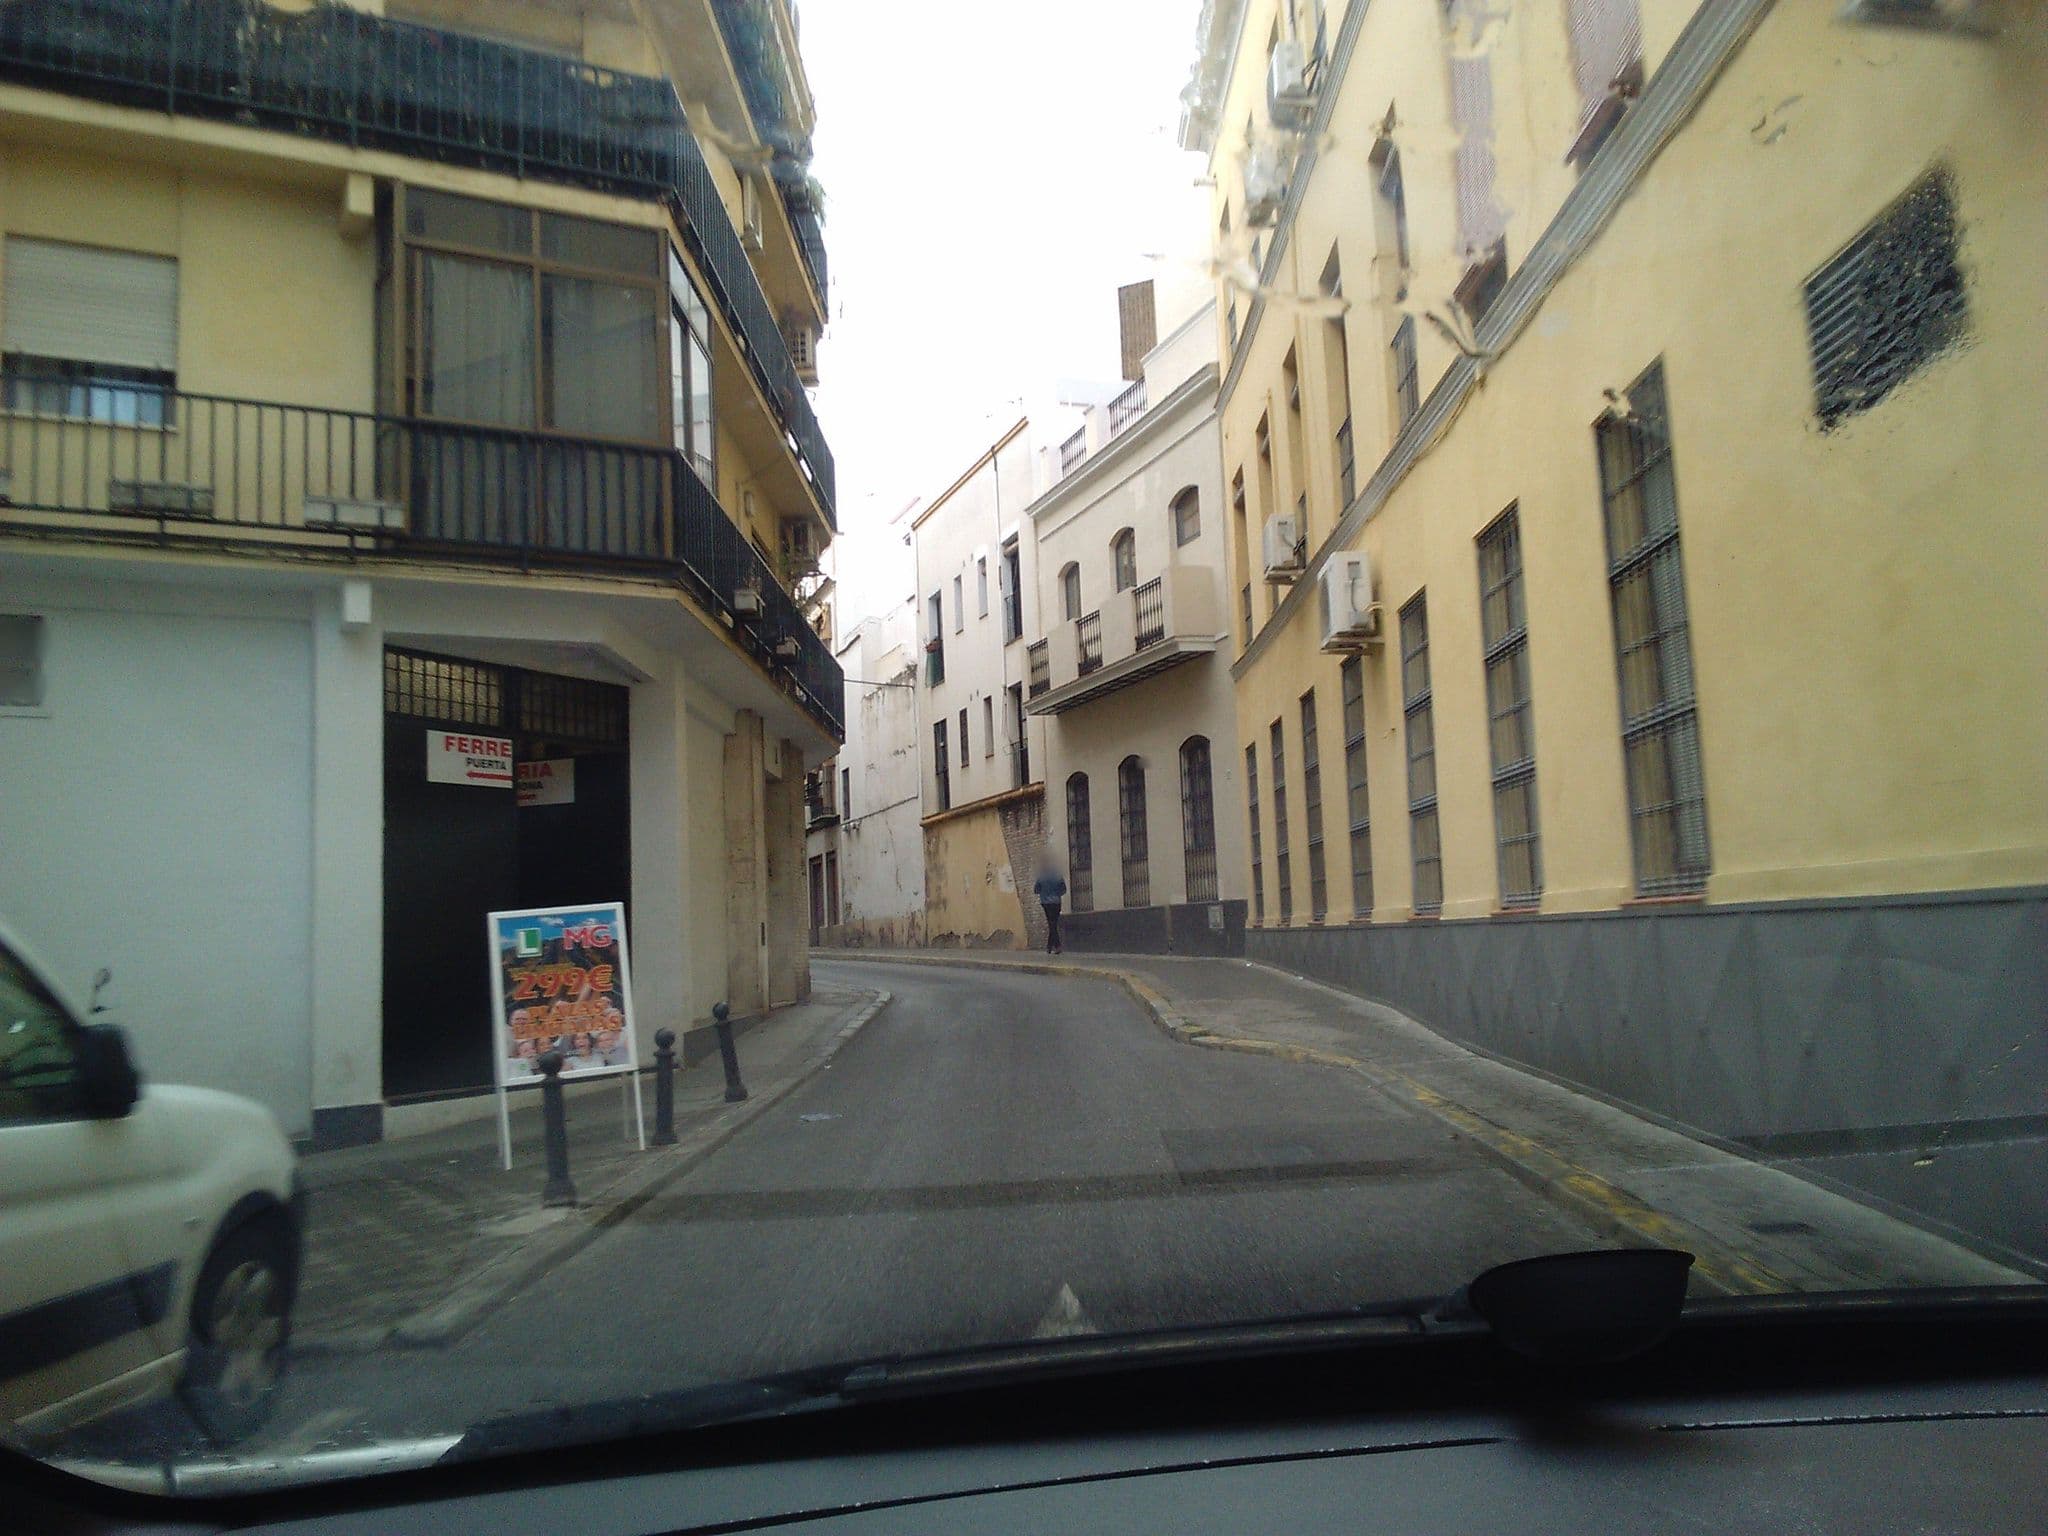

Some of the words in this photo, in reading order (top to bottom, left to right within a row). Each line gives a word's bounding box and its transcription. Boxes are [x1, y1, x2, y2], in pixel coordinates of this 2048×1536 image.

[444, 735, 512, 758] FERRE
[466, 757, 507, 770] PUERTA
[562, 925, 613, 951] MG
[512, 964, 614, 1000] 299€
